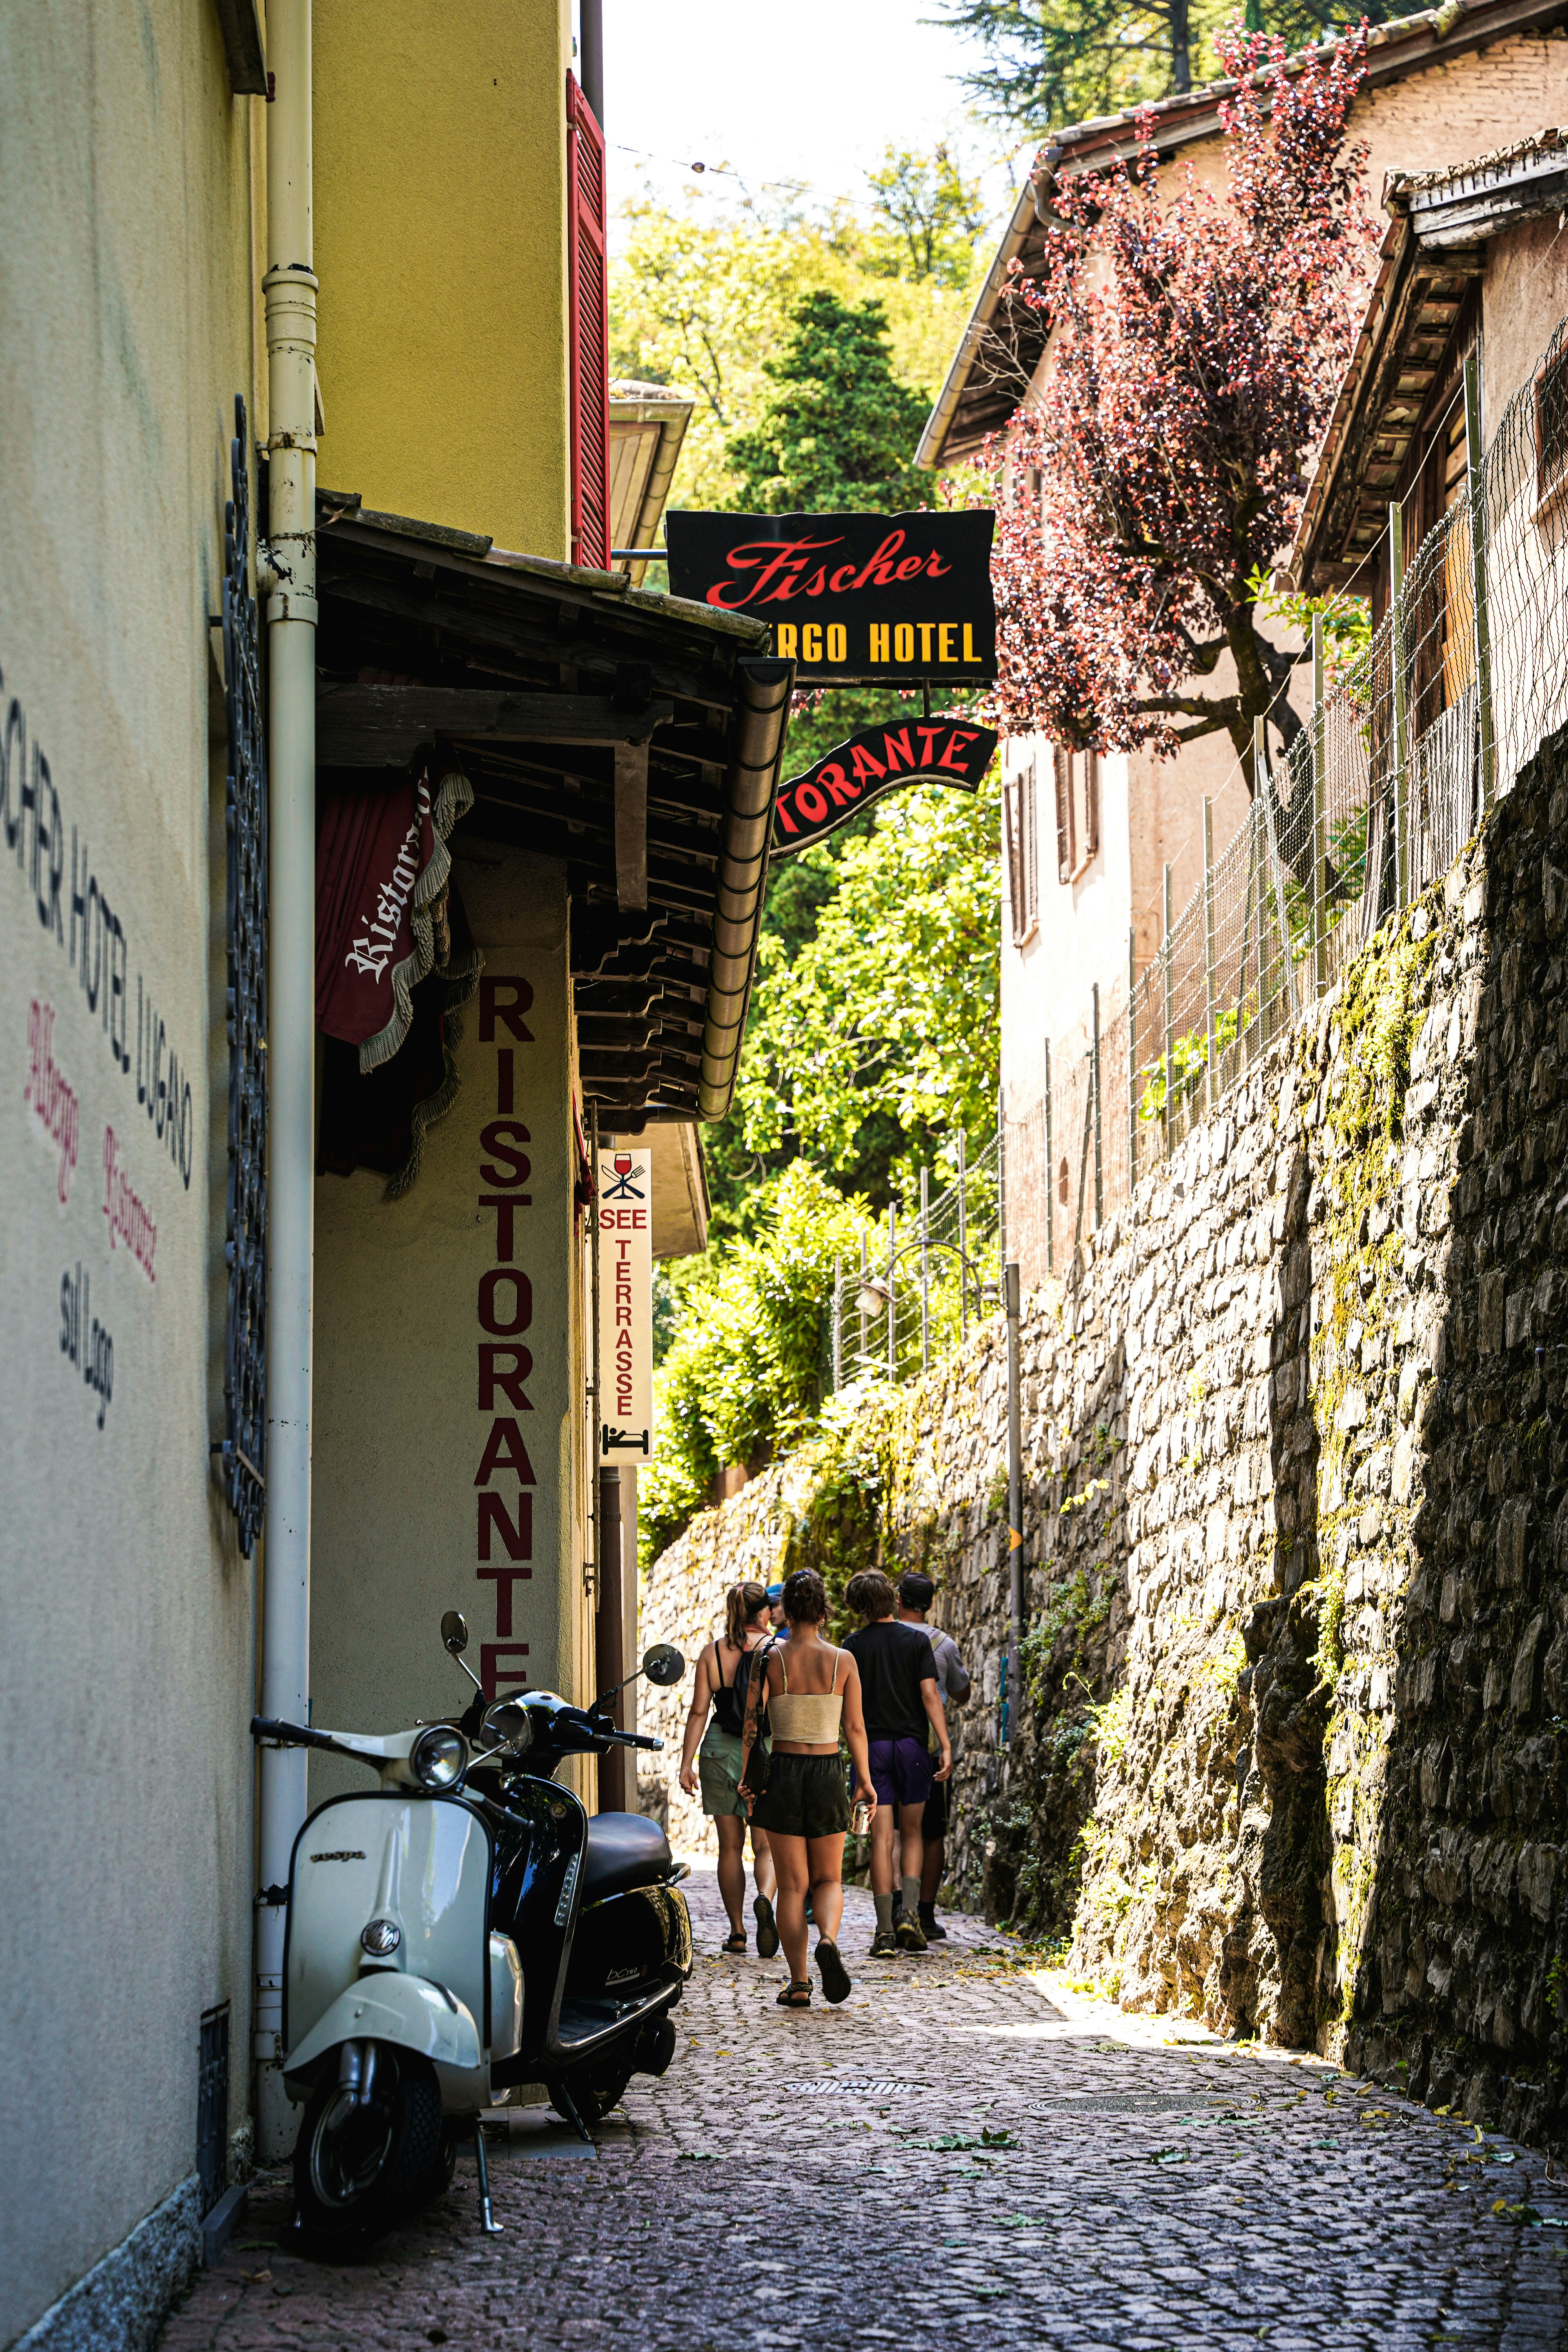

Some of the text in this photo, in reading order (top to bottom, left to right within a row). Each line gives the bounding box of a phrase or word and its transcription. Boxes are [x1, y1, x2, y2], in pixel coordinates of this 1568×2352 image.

[706, 529, 952, 610] Fischer
[768, 622, 982, 662] RGO HOTEL
[0, 661, 192, 1190] CHER HOTEL LUGANO
[599, 1209, 647, 1229] SEE
[615, 1240, 633, 1416] TERRASSE
